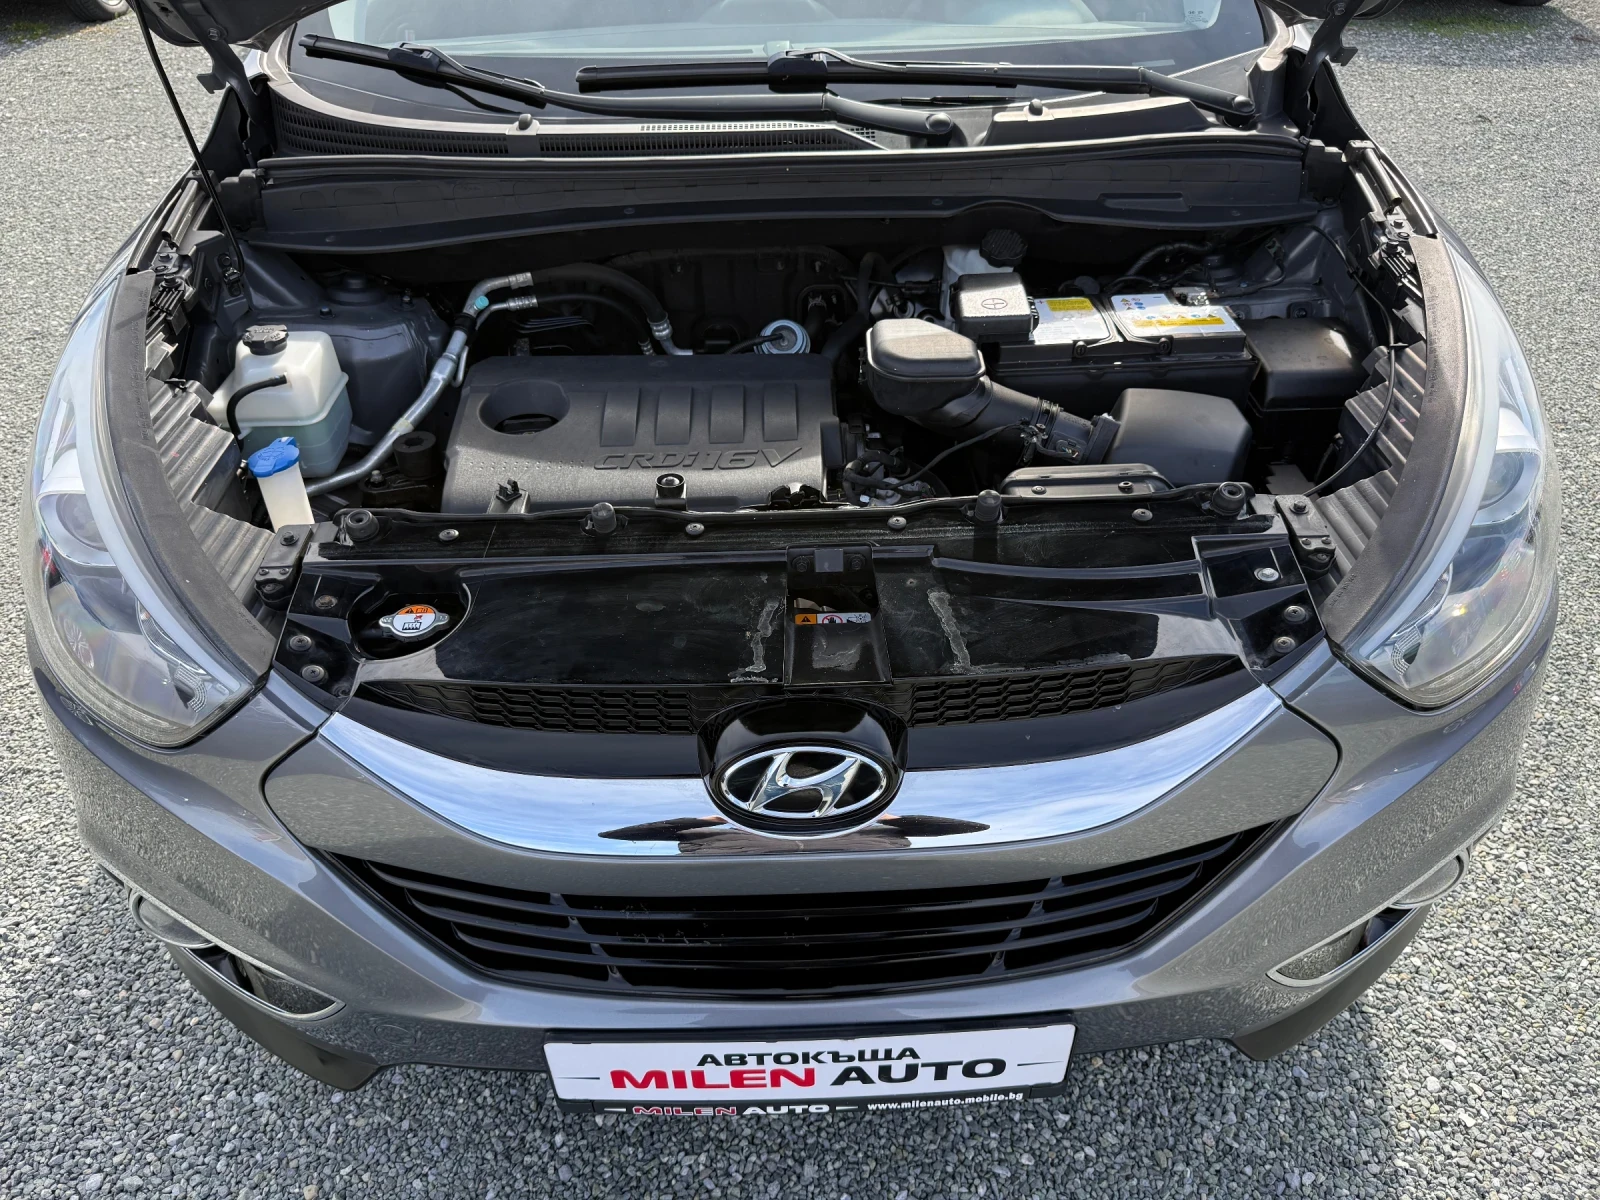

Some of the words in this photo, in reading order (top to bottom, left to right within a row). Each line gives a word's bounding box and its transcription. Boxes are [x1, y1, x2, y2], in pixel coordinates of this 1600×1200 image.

[609, 1067, 816, 1090] MILEN
[829, 1057, 1007, 1087] AUTO
[632, 1105, 737, 1116] MILEN
[742, 1103, 830, 1115] AUTO
[867, 1091, 1024, 1111] www.milenauto.mobile.bg
